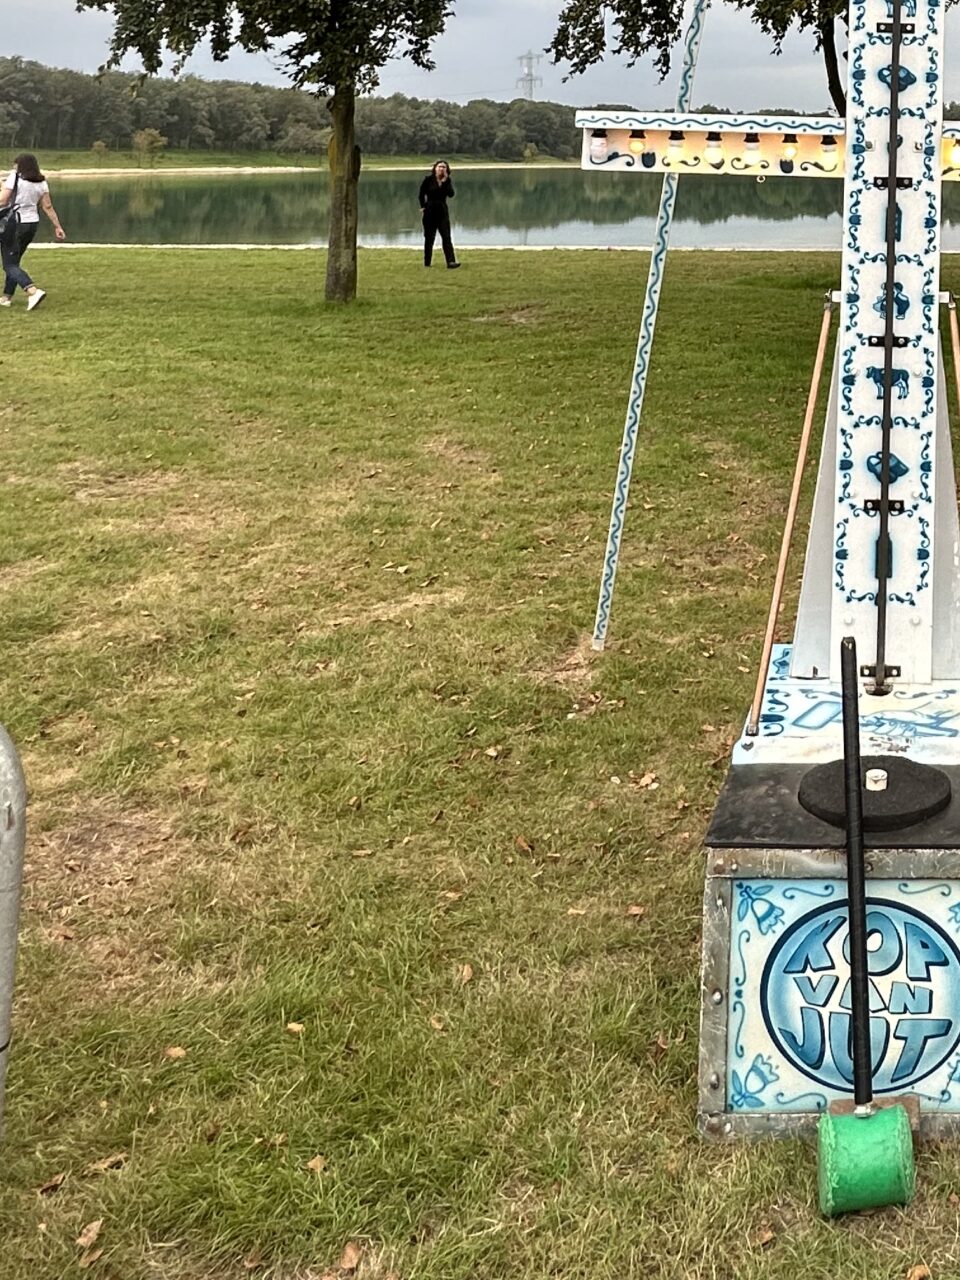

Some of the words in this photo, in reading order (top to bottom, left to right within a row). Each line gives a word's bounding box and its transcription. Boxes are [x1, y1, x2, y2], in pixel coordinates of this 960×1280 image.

[784, 911, 950, 981] KOP
[794, 974, 933, 1014] VAN
[779, 1007, 952, 1084] JUT
